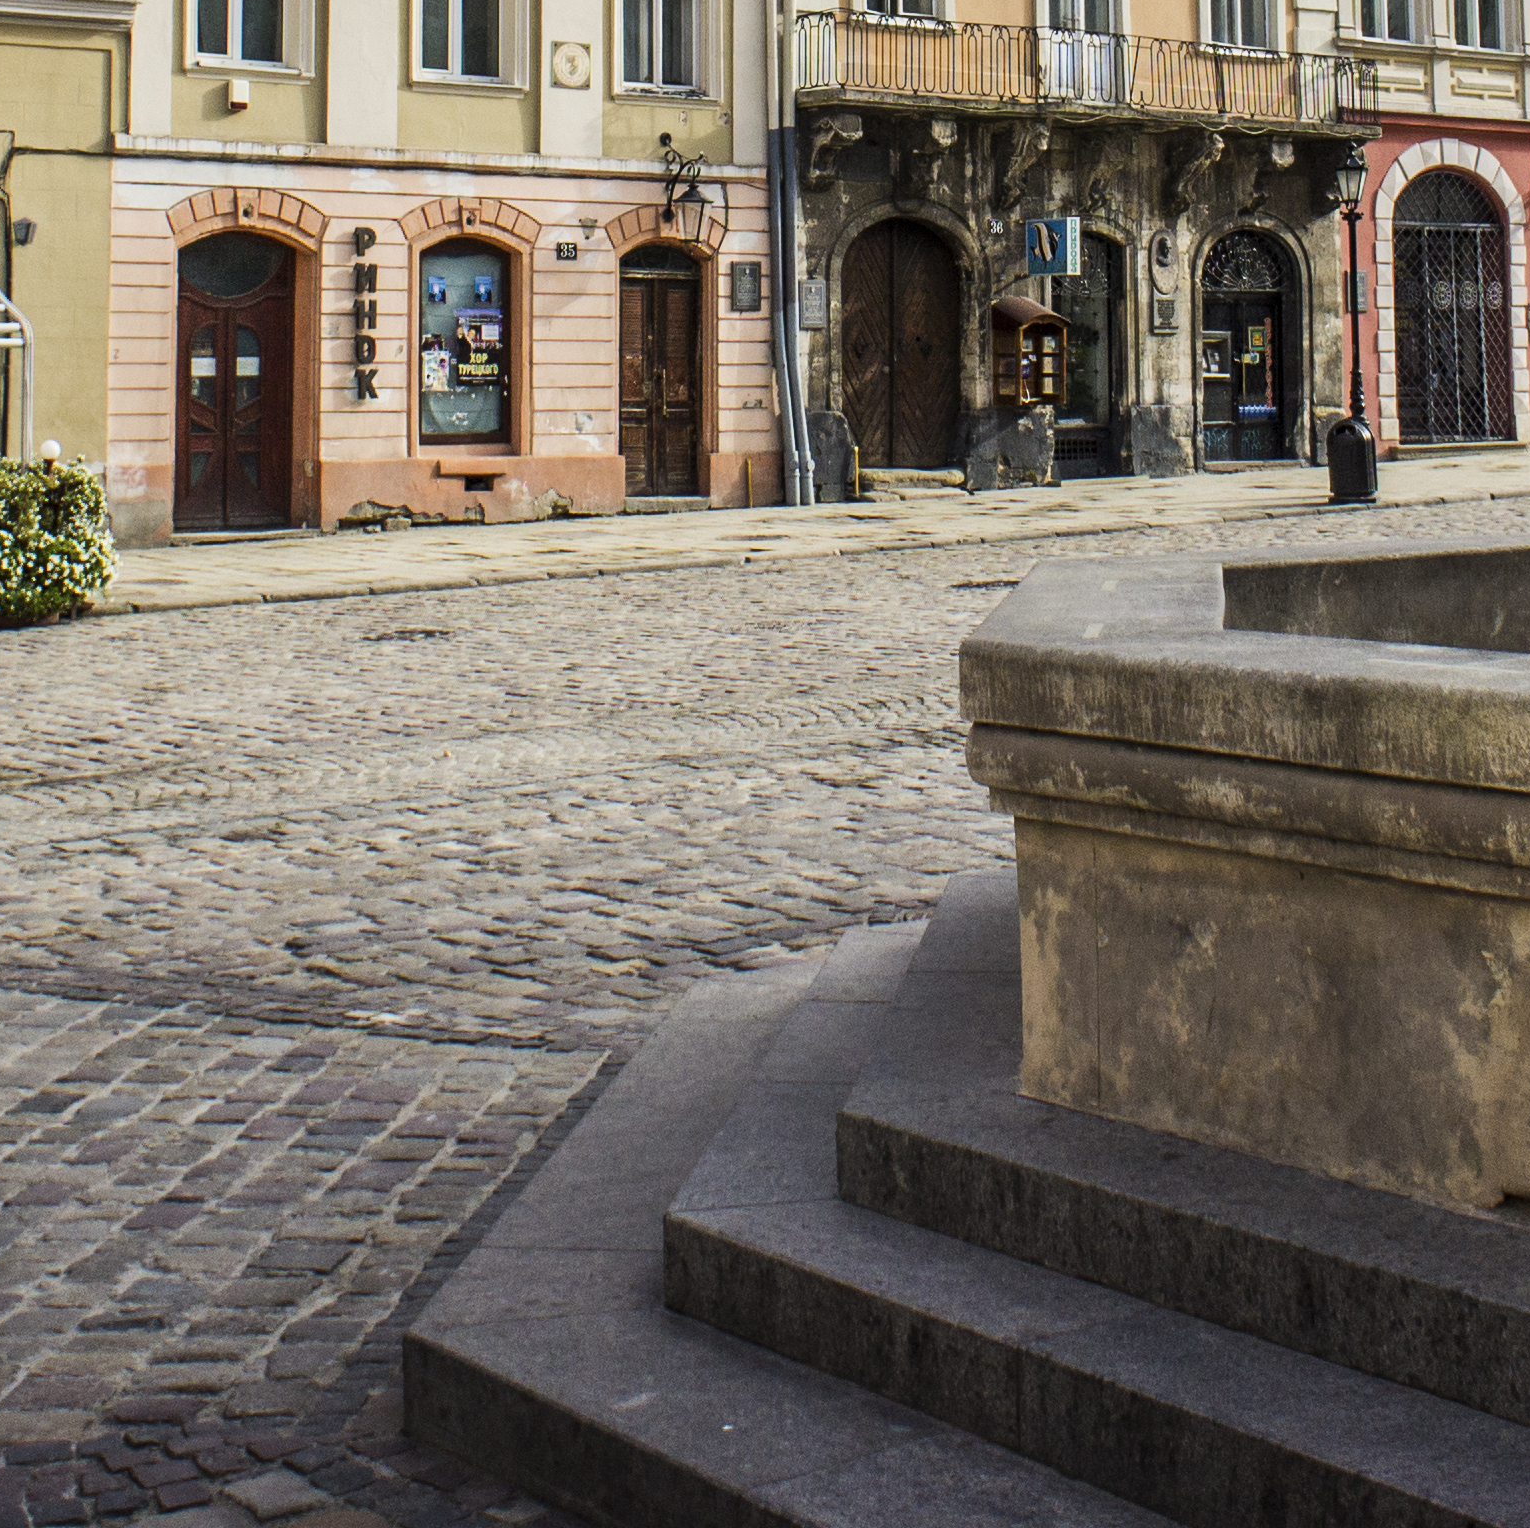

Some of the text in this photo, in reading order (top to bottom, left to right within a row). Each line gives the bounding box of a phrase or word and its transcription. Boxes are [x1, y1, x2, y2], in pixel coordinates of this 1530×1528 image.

[560, 243, 575, 258] 35
[353, 226, 379, 400] РИНОК
[470, 353, 488, 364] ХОР
